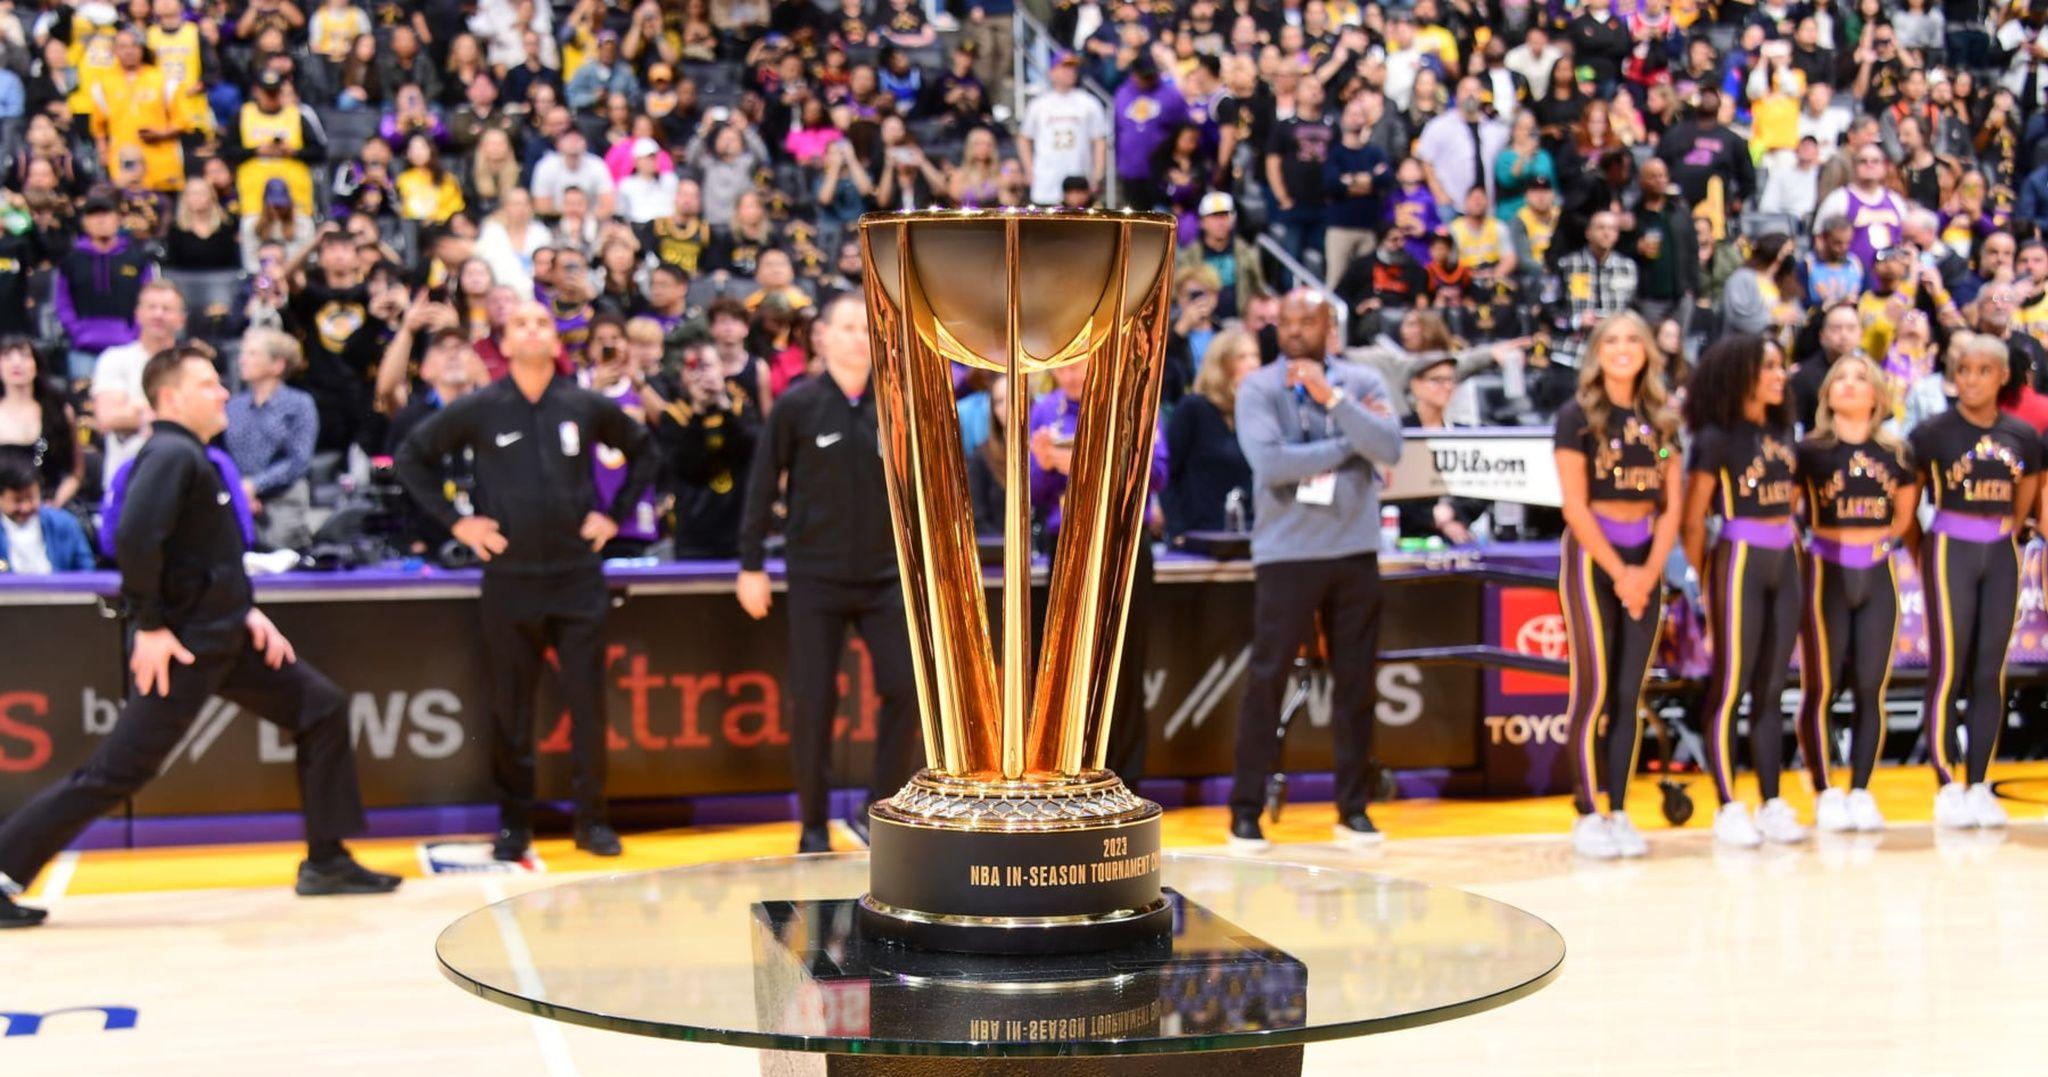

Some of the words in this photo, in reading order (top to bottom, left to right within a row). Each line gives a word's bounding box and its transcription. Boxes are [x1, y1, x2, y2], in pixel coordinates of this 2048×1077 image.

[1431, 449, 1526, 474] Wilson
[1484, 713, 1609, 745] TOYO
[1103, 836, 1128, 857] 2023
[970, 865, 1000, 887] NBA
[1006, 864, 1086, 887] IN-SEASON
[1090, 855, 1150, 883] TOURNAMENT
